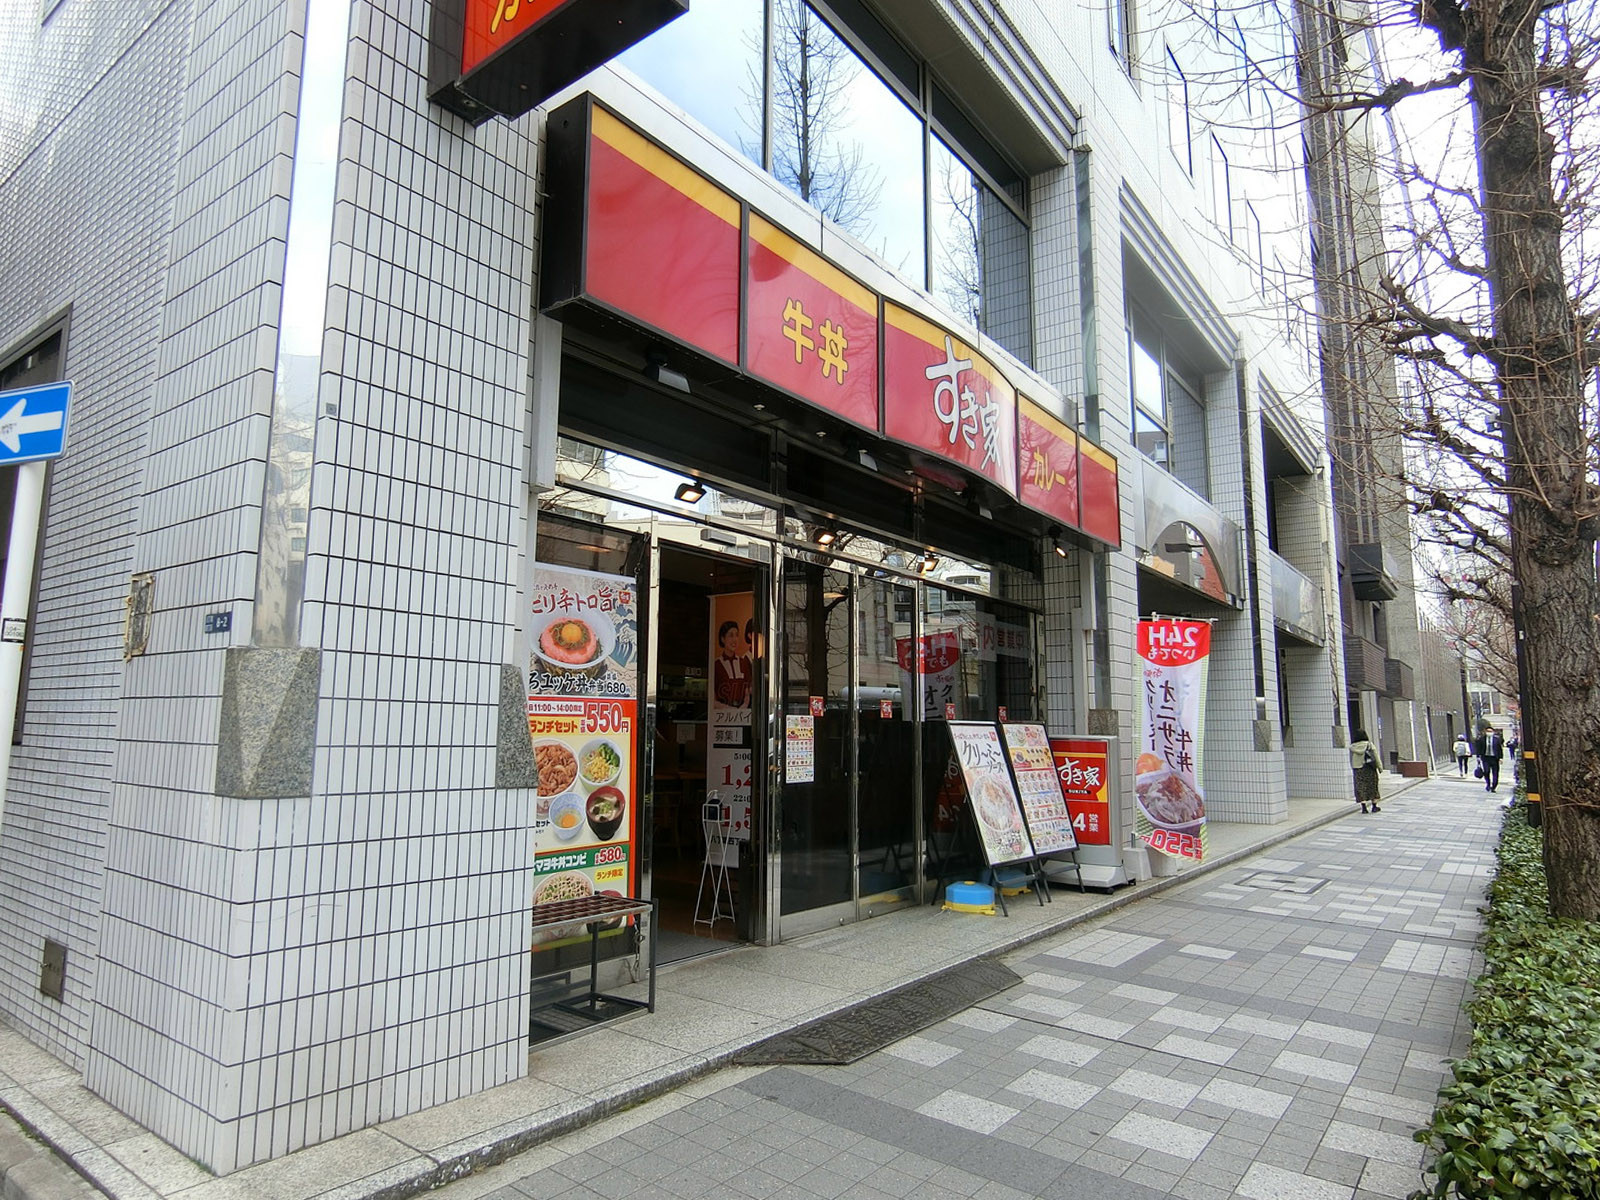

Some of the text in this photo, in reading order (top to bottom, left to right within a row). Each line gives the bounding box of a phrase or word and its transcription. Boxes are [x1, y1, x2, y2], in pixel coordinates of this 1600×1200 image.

[782, 297, 848, 385] 牛丼
[925, 335, 1001, 471] すき家
[1033, 448, 1066, 492] カレー
[530, 720, 577, 734] ランチセット
[586, 702, 629, 734] 550円
[1057, 757, 1101, 789] すき家
